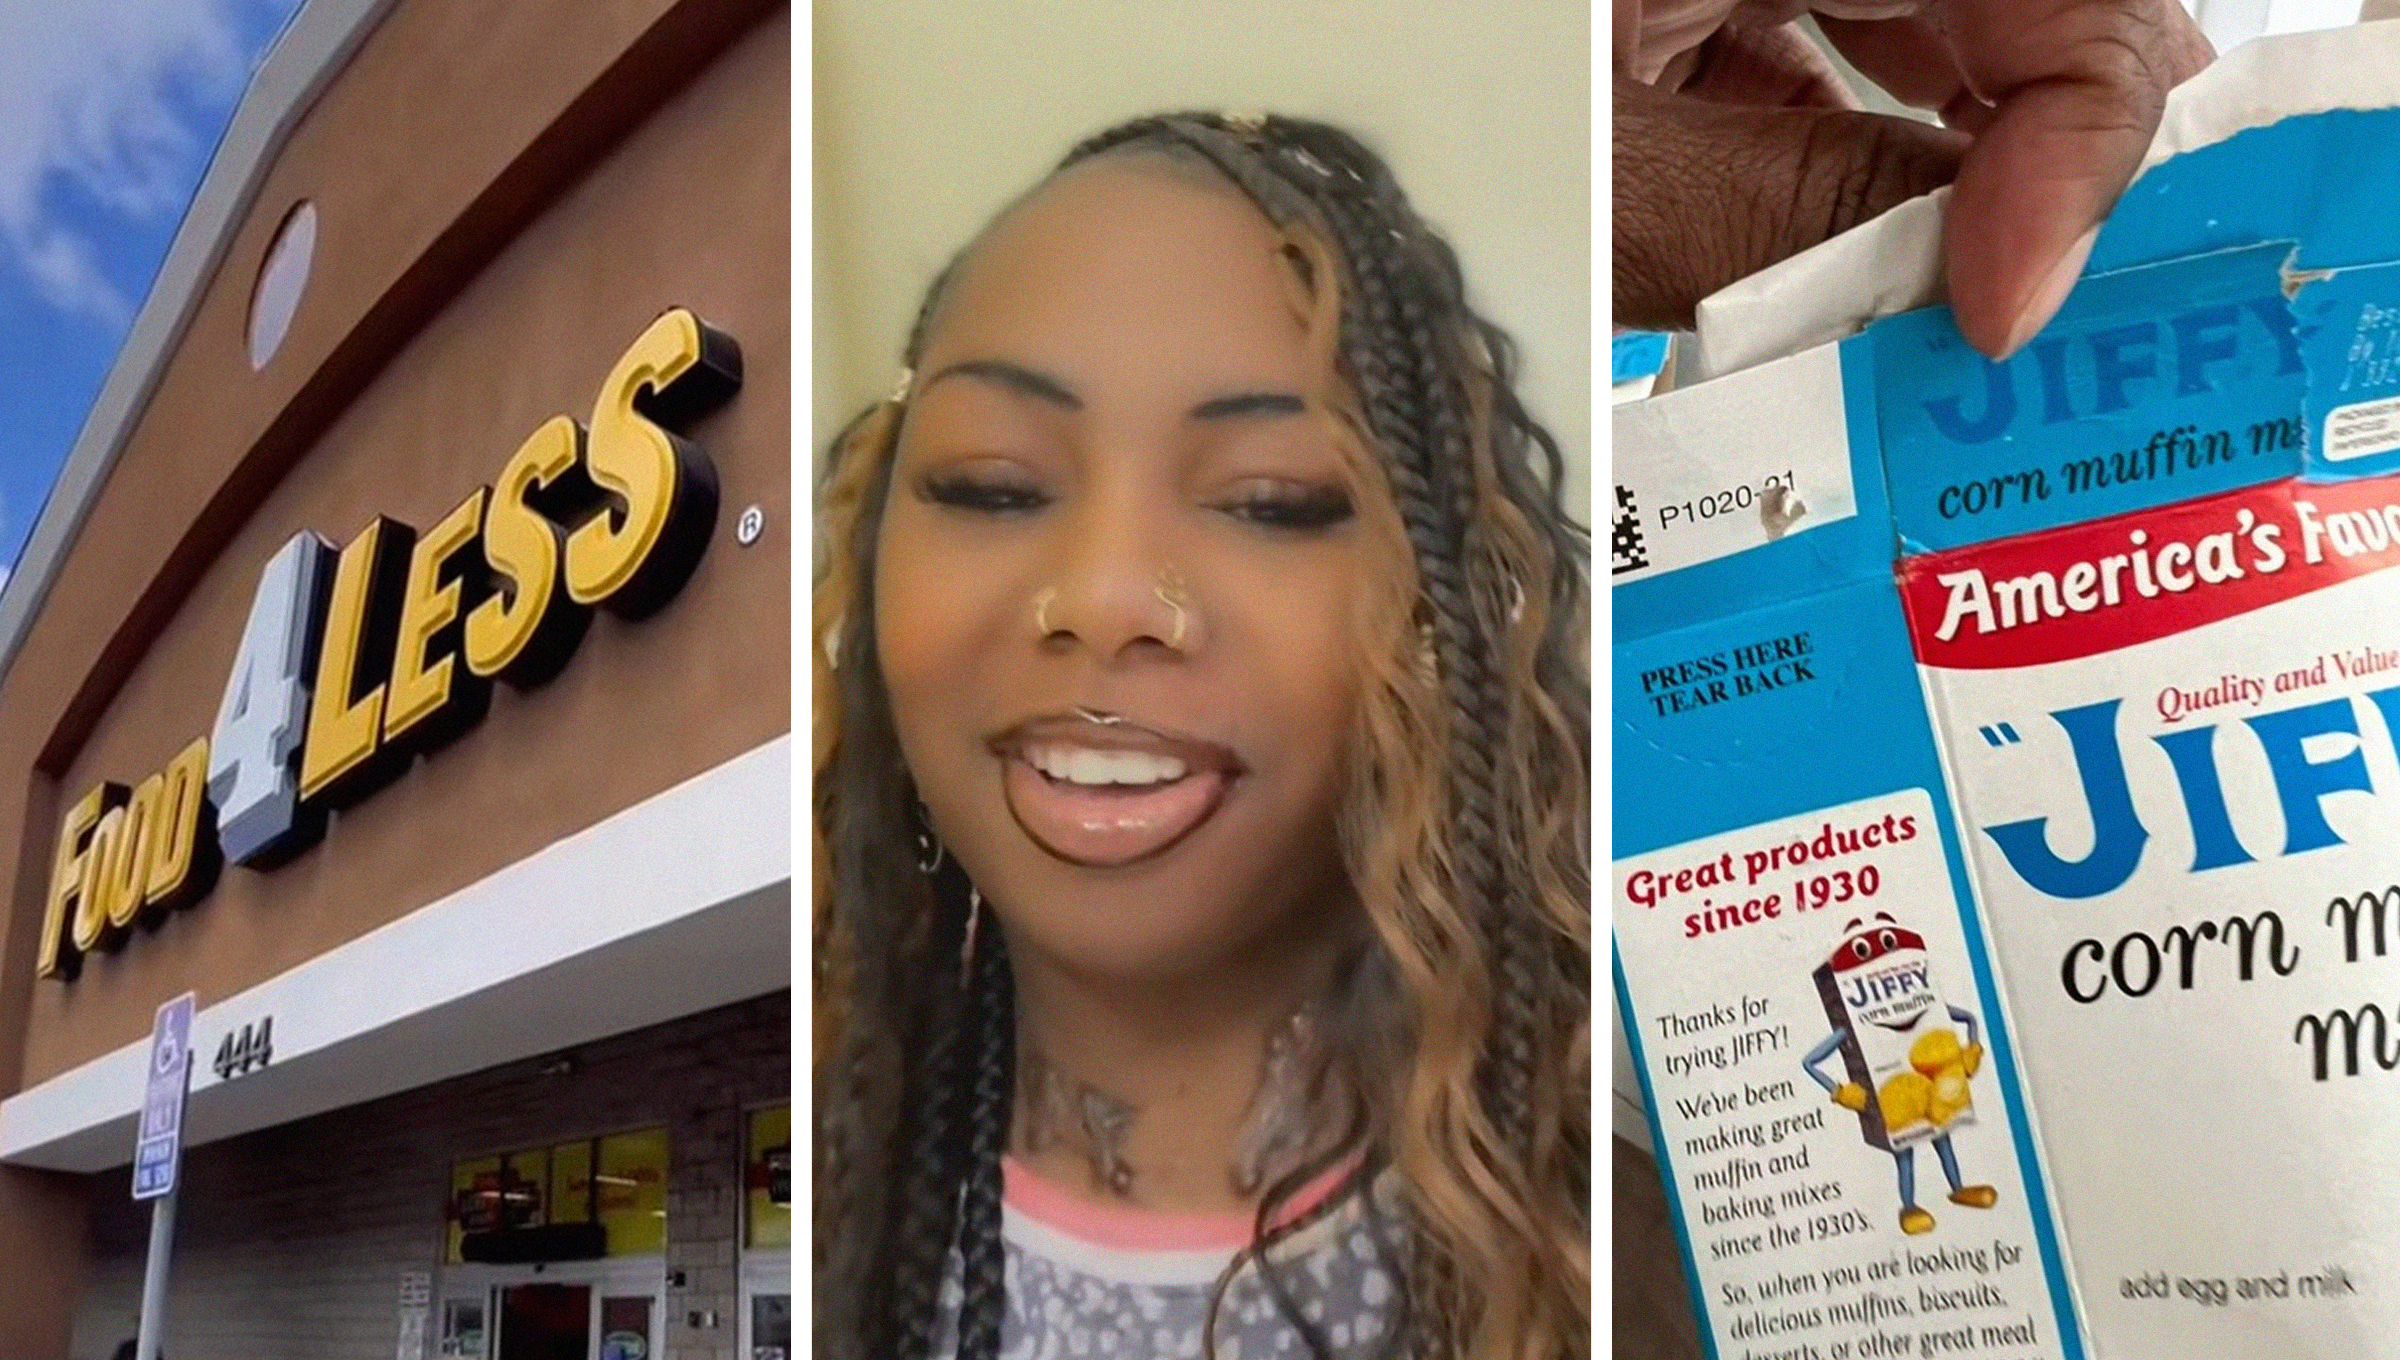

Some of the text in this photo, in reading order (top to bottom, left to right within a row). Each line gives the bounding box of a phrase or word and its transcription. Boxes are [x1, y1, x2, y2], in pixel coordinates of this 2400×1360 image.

[1937, 467, 2050, 520] corn
[2062, 424, 2237, 497] muffin
[1934, 508, 2287, 642] America's
[1640, 631, 1814, 694] PRESS HERE
[1650, 658, 1816, 718] TEAR BACK
[2157, 646, 2400, 723] Quality and Value
[206, 529, 332, 868] 4
[1626, 814, 1917, 909] Great products
[1684, 864, 1881, 939] since 1930
[2061, 910, 2300, 1004] corn
[213, 1015, 274, 1079] 444
[1656, 995, 1769, 1040] Thanks for
[1666, 1025, 1791, 1078] trying JIFFY!
[1676, 1080, 1796, 1121] We've been
[1685, 1106, 1825, 1157] making great
[1693, 1143, 1810, 1191] muffin and
[1702, 1181, 1842, 1227] baking mixes
[1710, 1233, 1763, 1262] since
[1769, 1221, 1802, 1250] the
[1721, 1238, 2022, 1308] So, when you are looking for
[2119, 1270, 2170, 1300] add
[2176, 1276, 2229, 1307] egg
[2235, 1267, 2290, 1301] and
[1729, 1282, 2008, 1341] delicious muffins, biscuits,
[1831, 1342, 1850, 1360] or
[1857, 1329, 1911, 1357] other
[1920, 1325, 1975, 1360] great
[1982, 1314, 2038, 1348] meal
